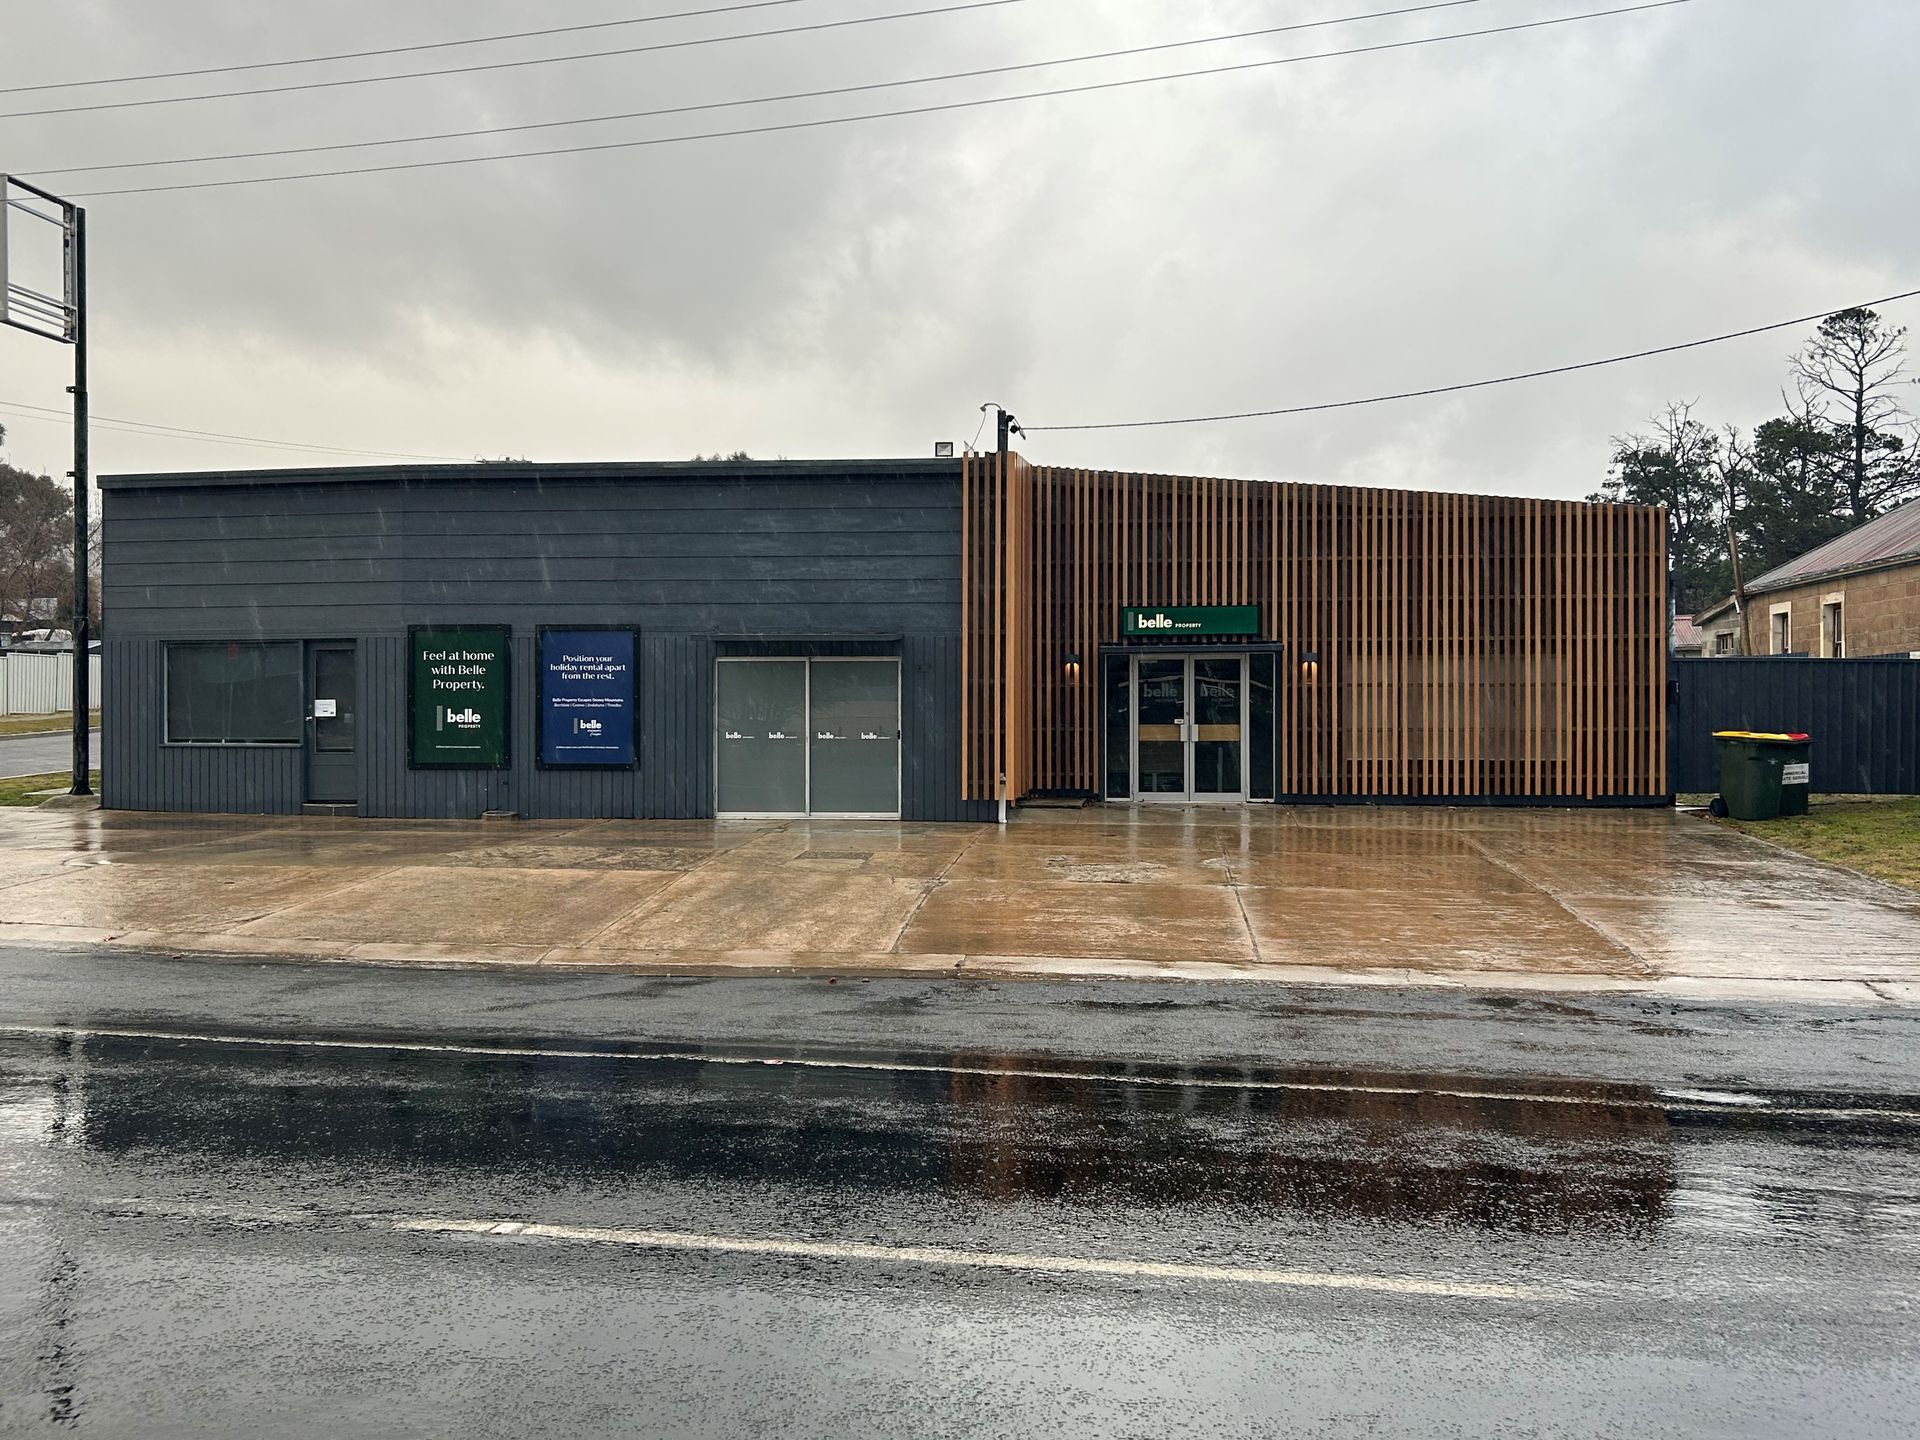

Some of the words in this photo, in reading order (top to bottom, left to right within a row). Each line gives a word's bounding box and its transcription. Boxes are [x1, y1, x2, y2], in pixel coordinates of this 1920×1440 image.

[1138, 614, 1172, 628] belle
[423, 651, 446, 660] Feel
[448, 651, 460, 660] at
[463, 650, 494, 660] home
[431, 664, 456, 674] with
[458, 665, 486, 674] Belle
[550, 664, 578, 672] holiday
[432, 679, 485, 692] Property.
[1144, 682, 1178, 698] belle
[447, 708, 481, 722] belle
[580, 719, 602, 729] belle
